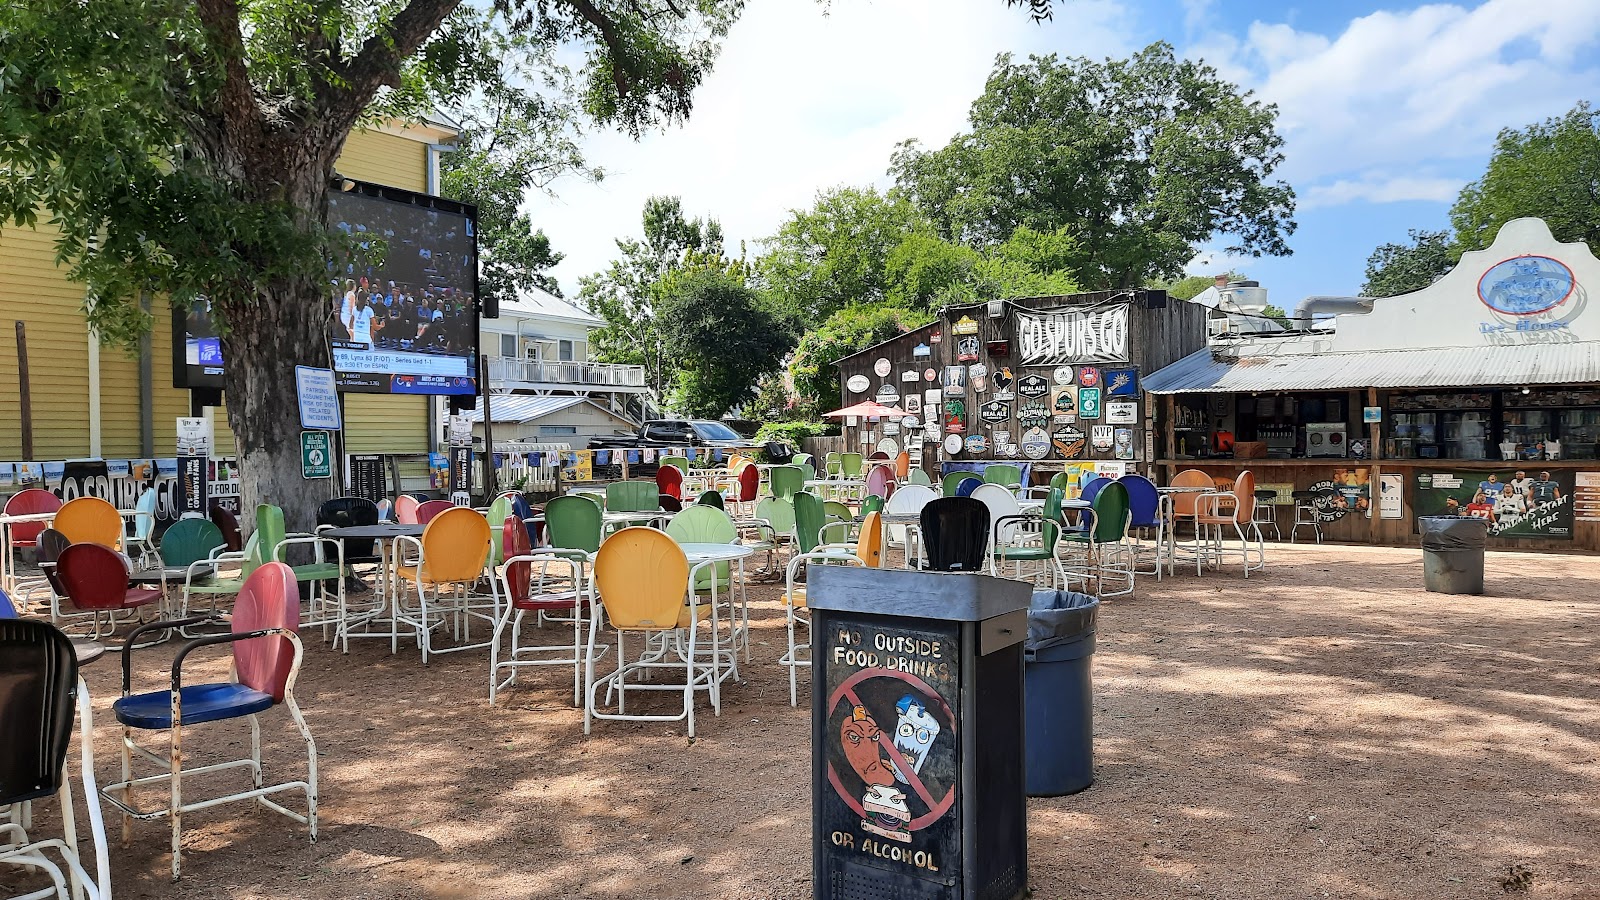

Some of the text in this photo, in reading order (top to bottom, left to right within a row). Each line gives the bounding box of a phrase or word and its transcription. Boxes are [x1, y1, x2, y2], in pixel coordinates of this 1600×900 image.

[1020, 310, 1125, 358] GO SPURS GO
[395, 356, 412, 364] Series
[303, 393, 322, 401] ASSUME
[305, 387, 329, 395] PATRONS
[1094, 427, 1112, 437] NVP
[215, 484, 230, 494] FOR
[1540, 486, 1545, 496] 1
[1492, 509, 1536, 536] SUNDAYS
[1539, 494, 1568, 515] START
[1531, 512, 1559, 530] HERE
[874, 633, 941, 658] OUTSIDE
[887, 656, 951, 681] DRINKS
[831, 831, 938, 872] OR ALCOHOL
